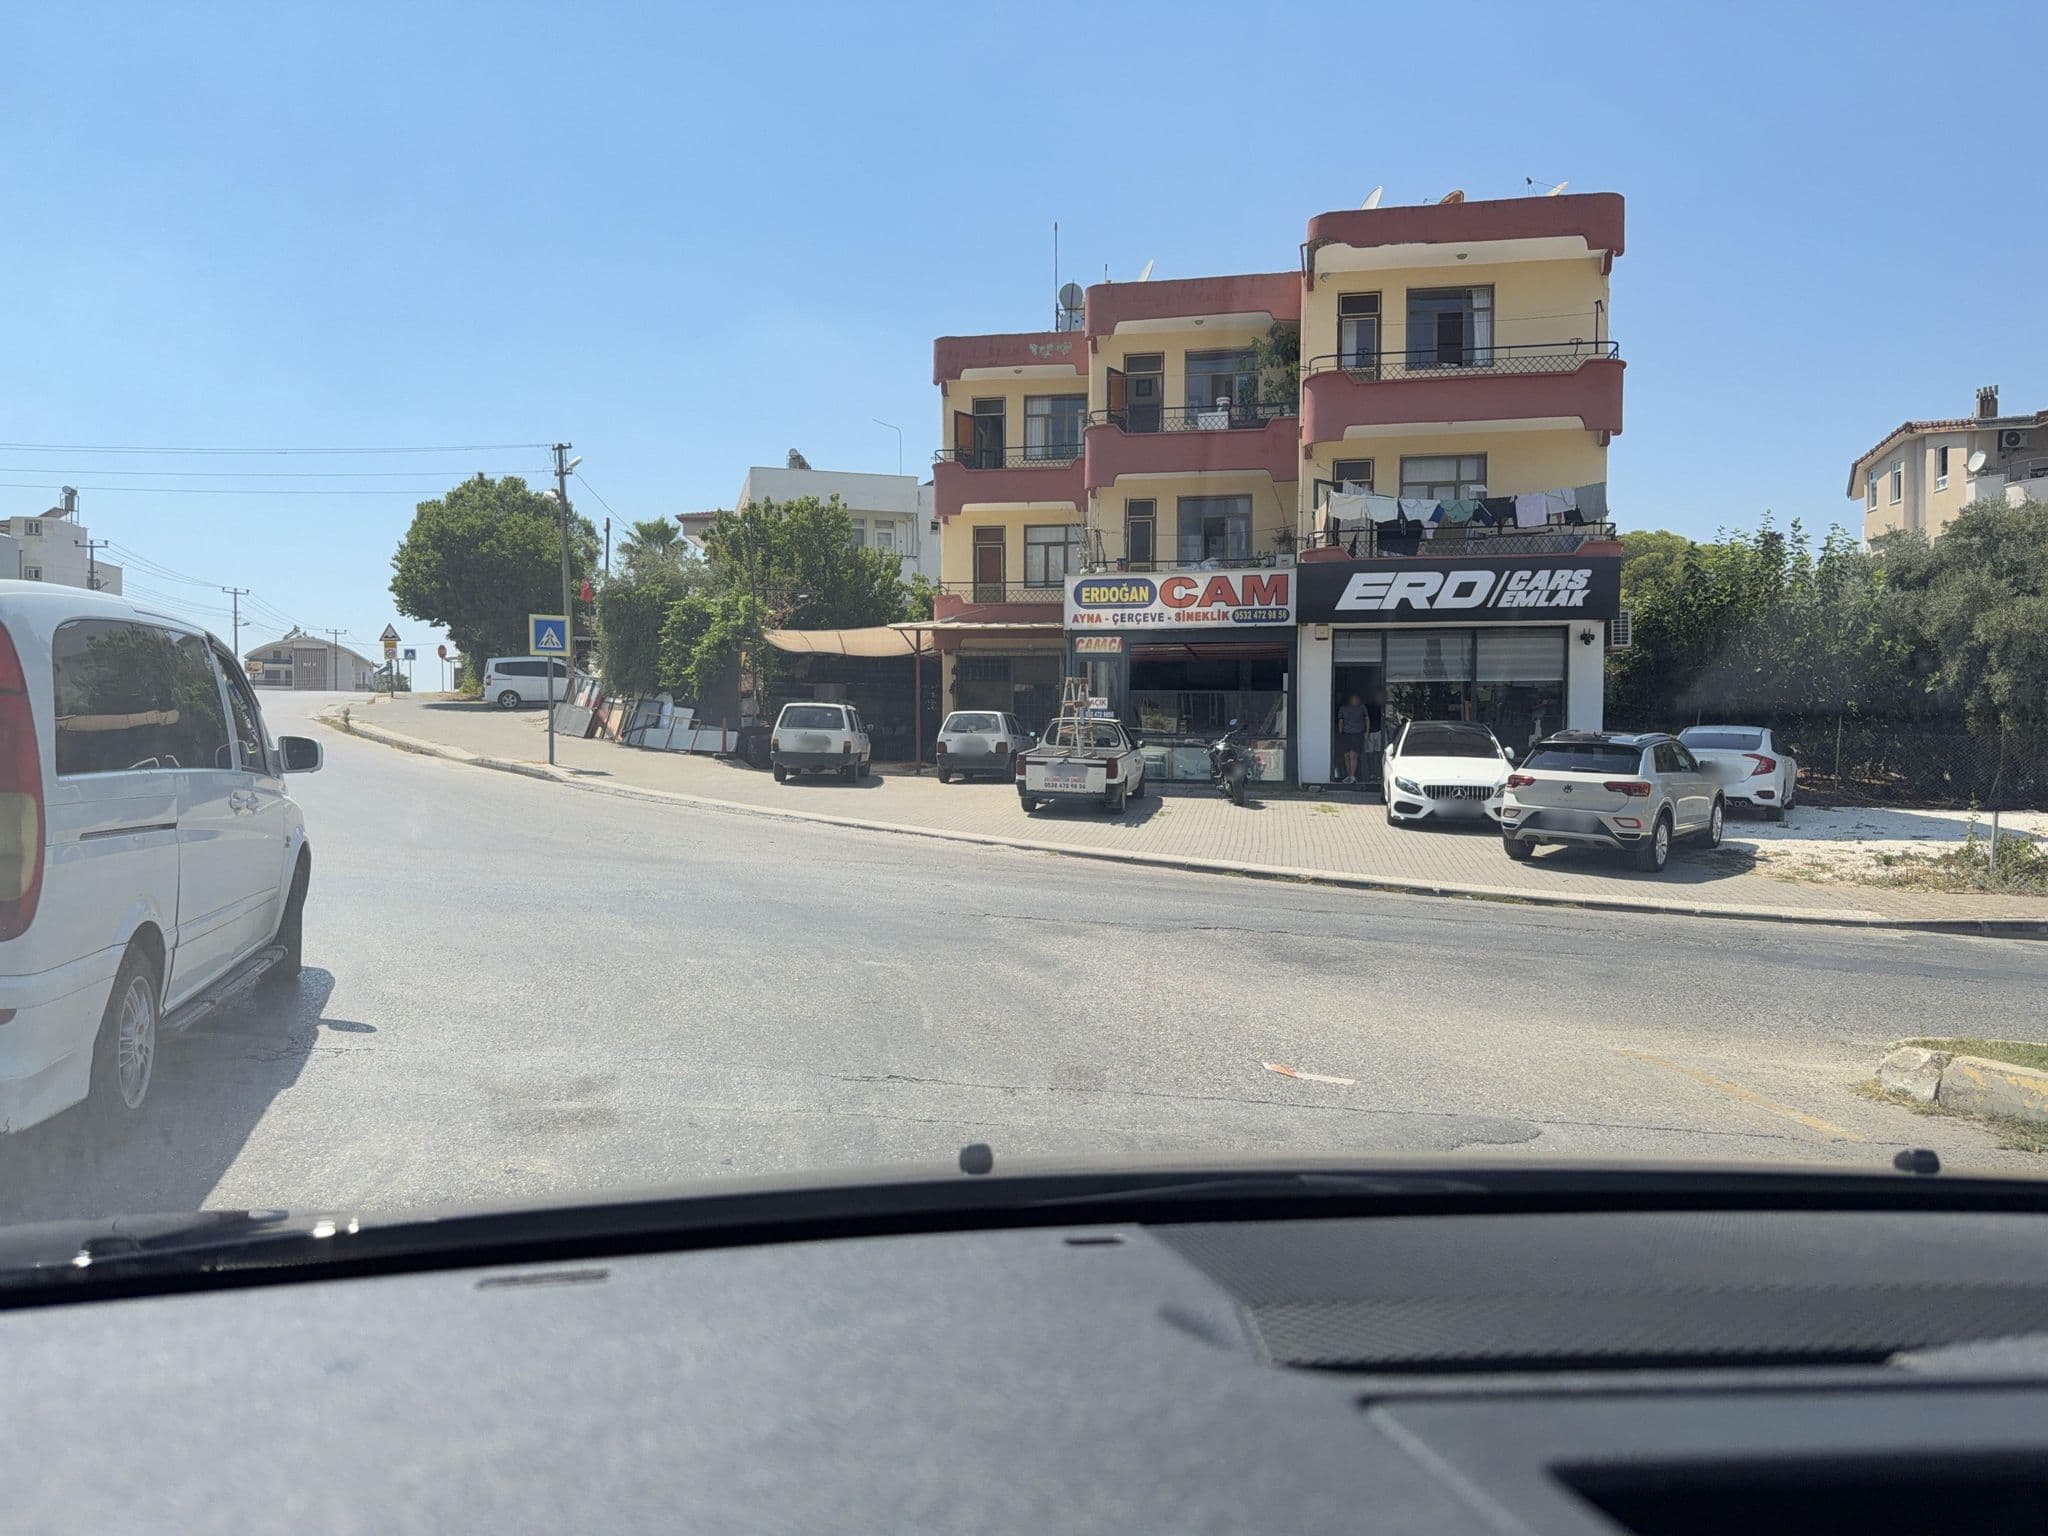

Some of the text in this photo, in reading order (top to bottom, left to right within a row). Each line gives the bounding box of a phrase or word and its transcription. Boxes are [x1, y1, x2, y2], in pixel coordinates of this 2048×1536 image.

[1335, 570, 1496, 610] ERD
[1507, 569, 1592, 590] CARS
[1081, 574, 1289, 608] ERDOĞAN CAM
[1497, 589, 1591, 608] EMLAK
[1072, 613, 1103, 624] AYNA
[1112, 612, 1165, 625] ÇERÇEVE
[1174, 609, 1230, 622] SİNEKLİK
